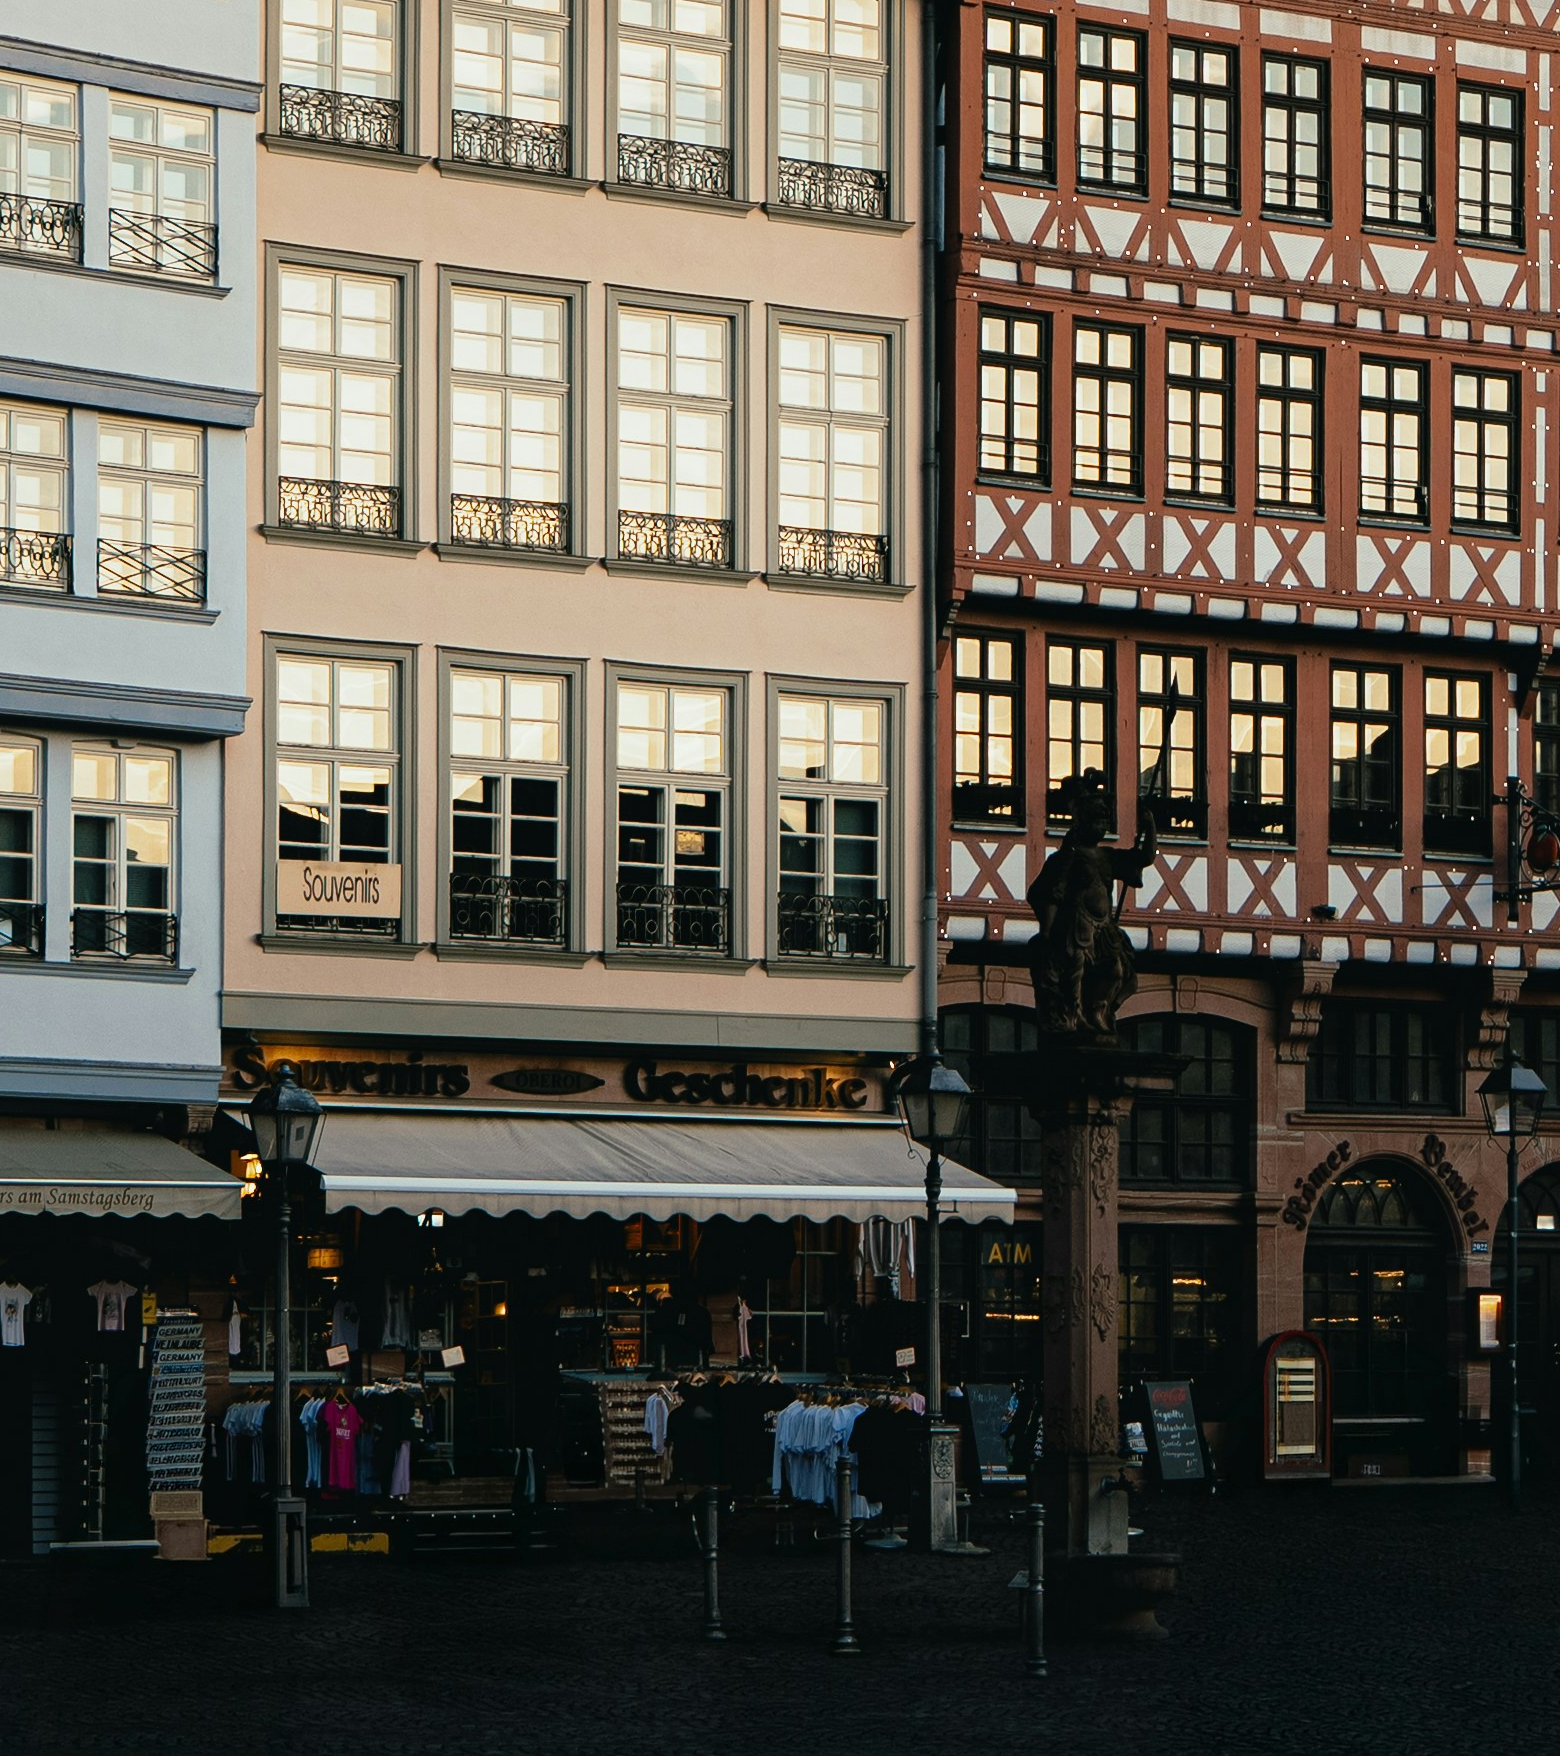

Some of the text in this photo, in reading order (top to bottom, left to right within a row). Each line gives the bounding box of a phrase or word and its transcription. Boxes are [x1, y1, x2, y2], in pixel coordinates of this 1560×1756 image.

[303, 866, 380, 904] Souvenirs
[233, 1046, 470, 1096] Souvenirs
[515, 1072, 582, 1089] OBEROI
[624, 1057, 868, 1109] Geschenke
[1283, 1133, 1489, 1238] Römer Bembel
[18, 1191, 42, 1205] am
[46, 1187, 154, 1211] Samstagsberg
[988, 1242, 1032, 1264] ATM
[158, 1327, 201, 1336] GERMANY
[159, 1353, 203, 1362] GERMANY
